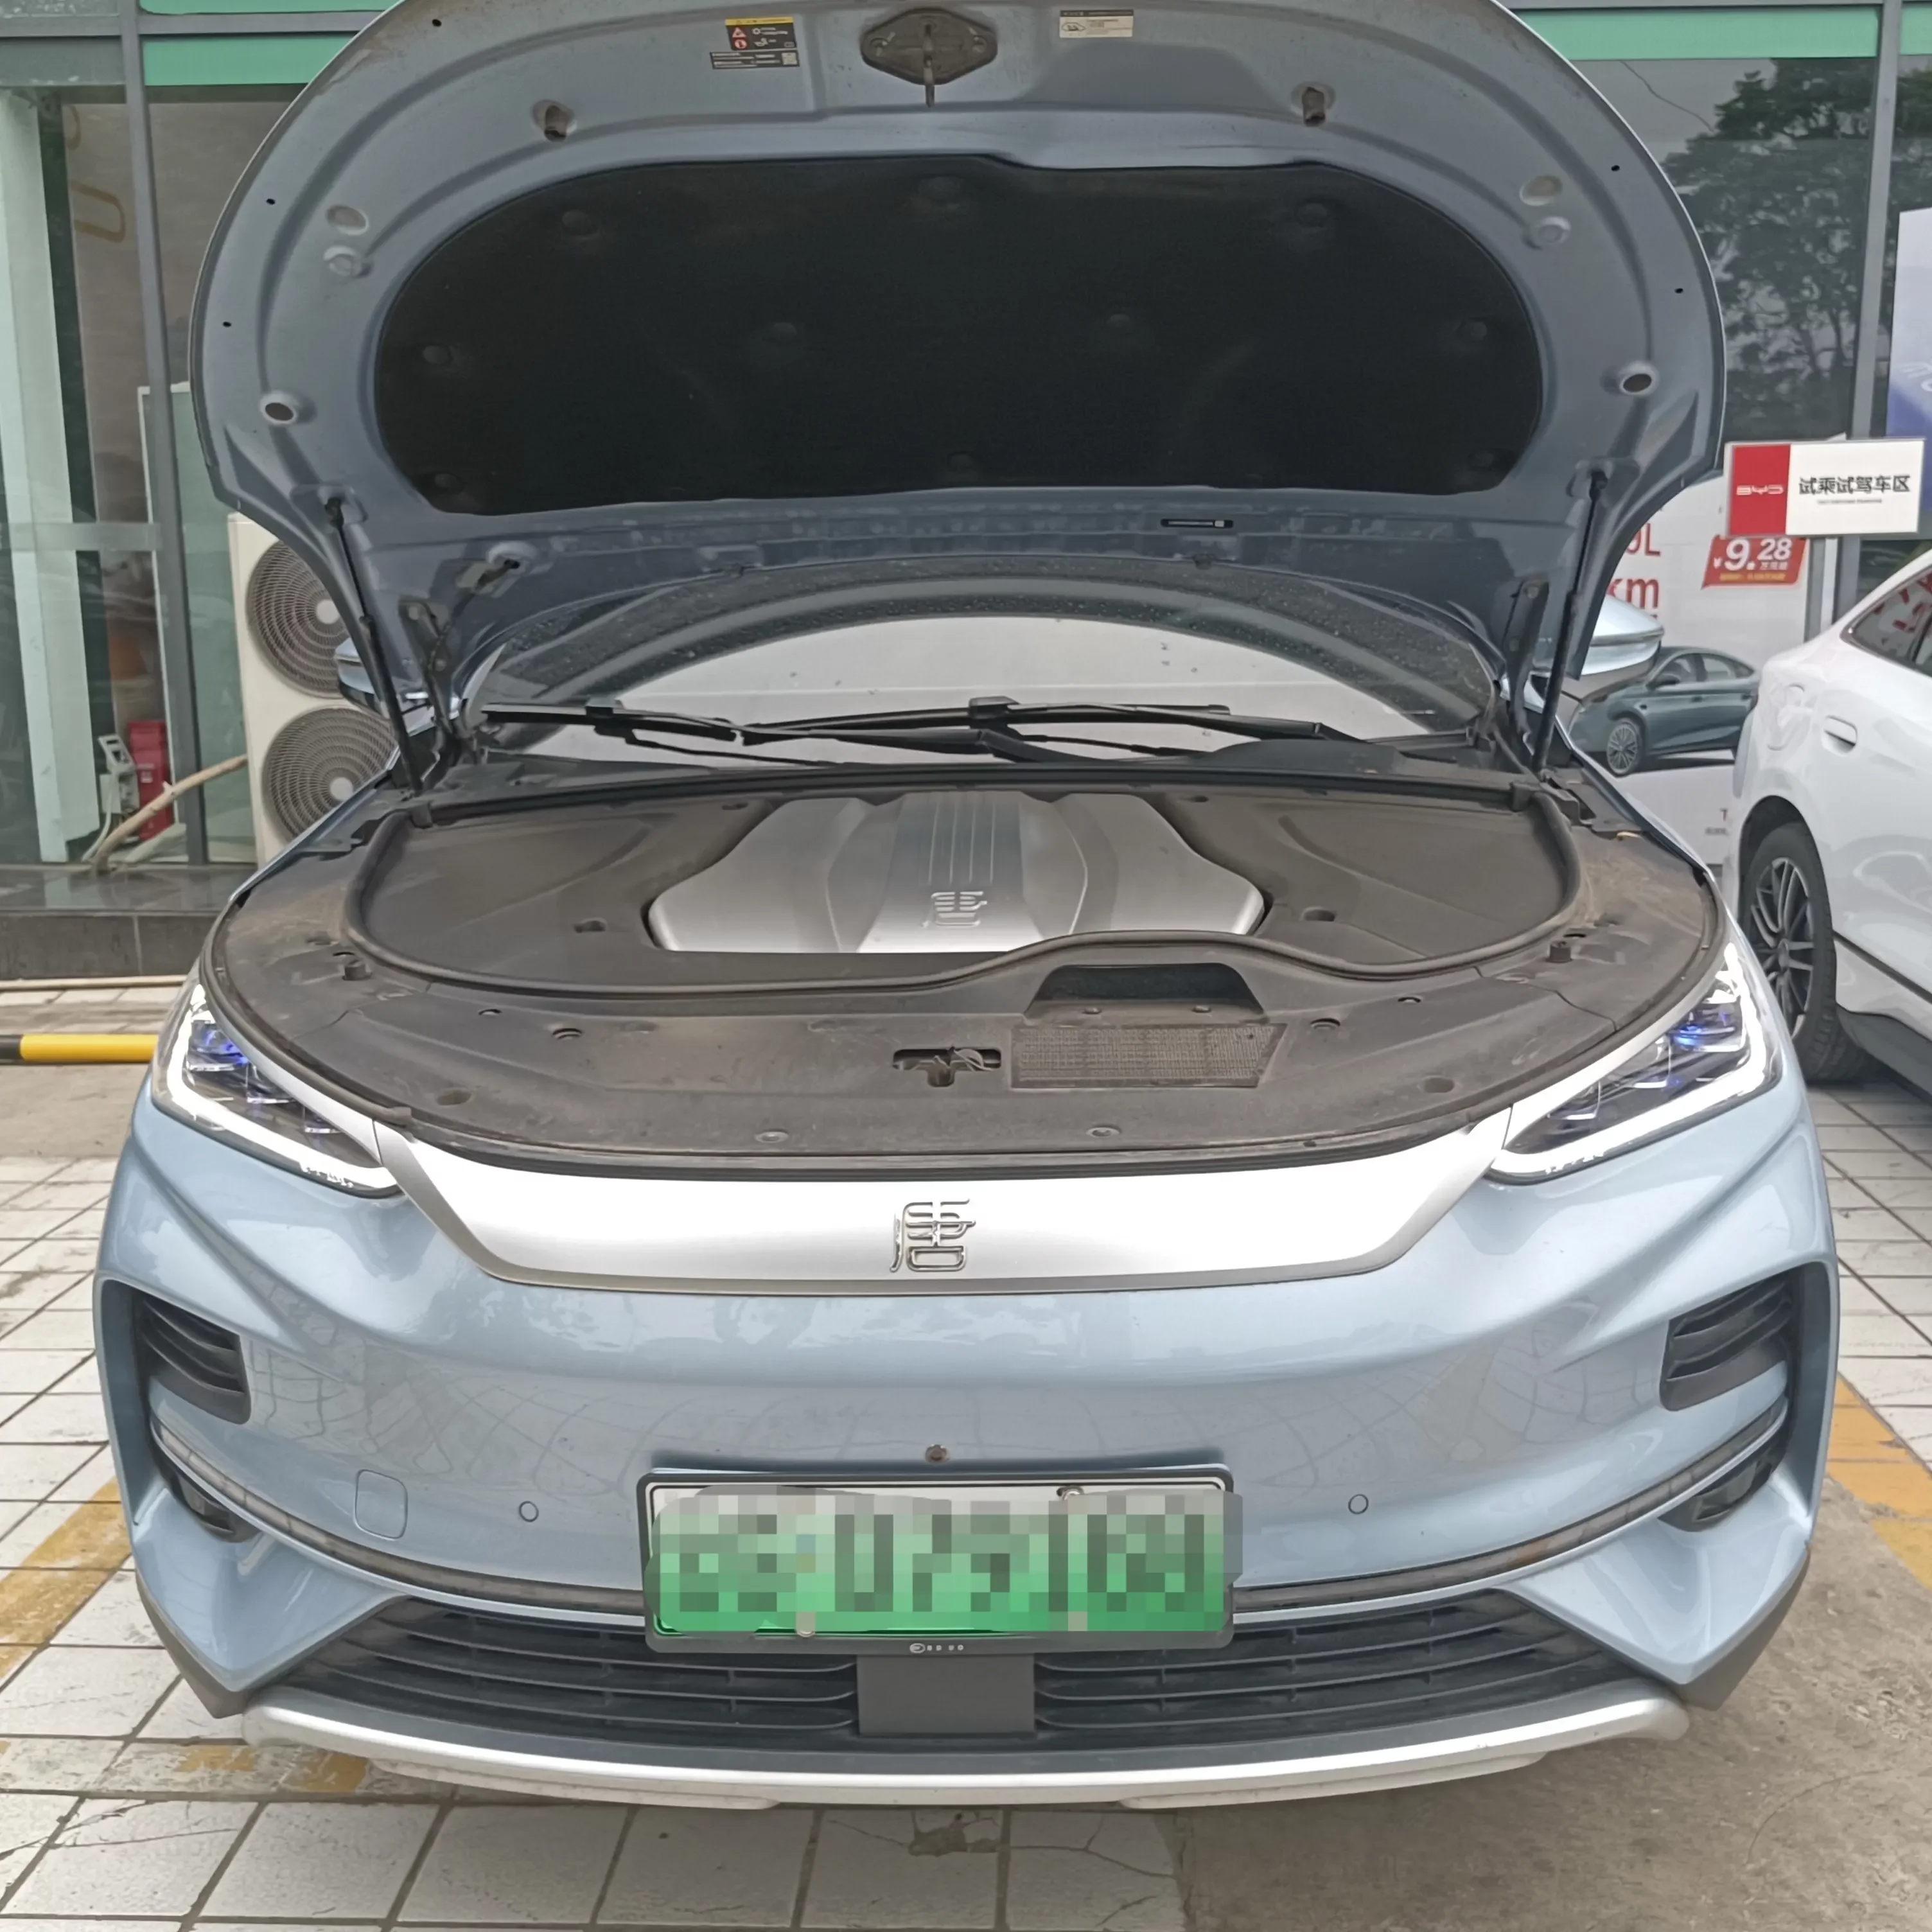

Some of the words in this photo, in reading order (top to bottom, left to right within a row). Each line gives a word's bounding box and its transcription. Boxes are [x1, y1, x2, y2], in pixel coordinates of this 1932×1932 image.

[1737, 484, 1784, 496] BYD
[1798, 475, 1911, 495] 试乘试驾车区
